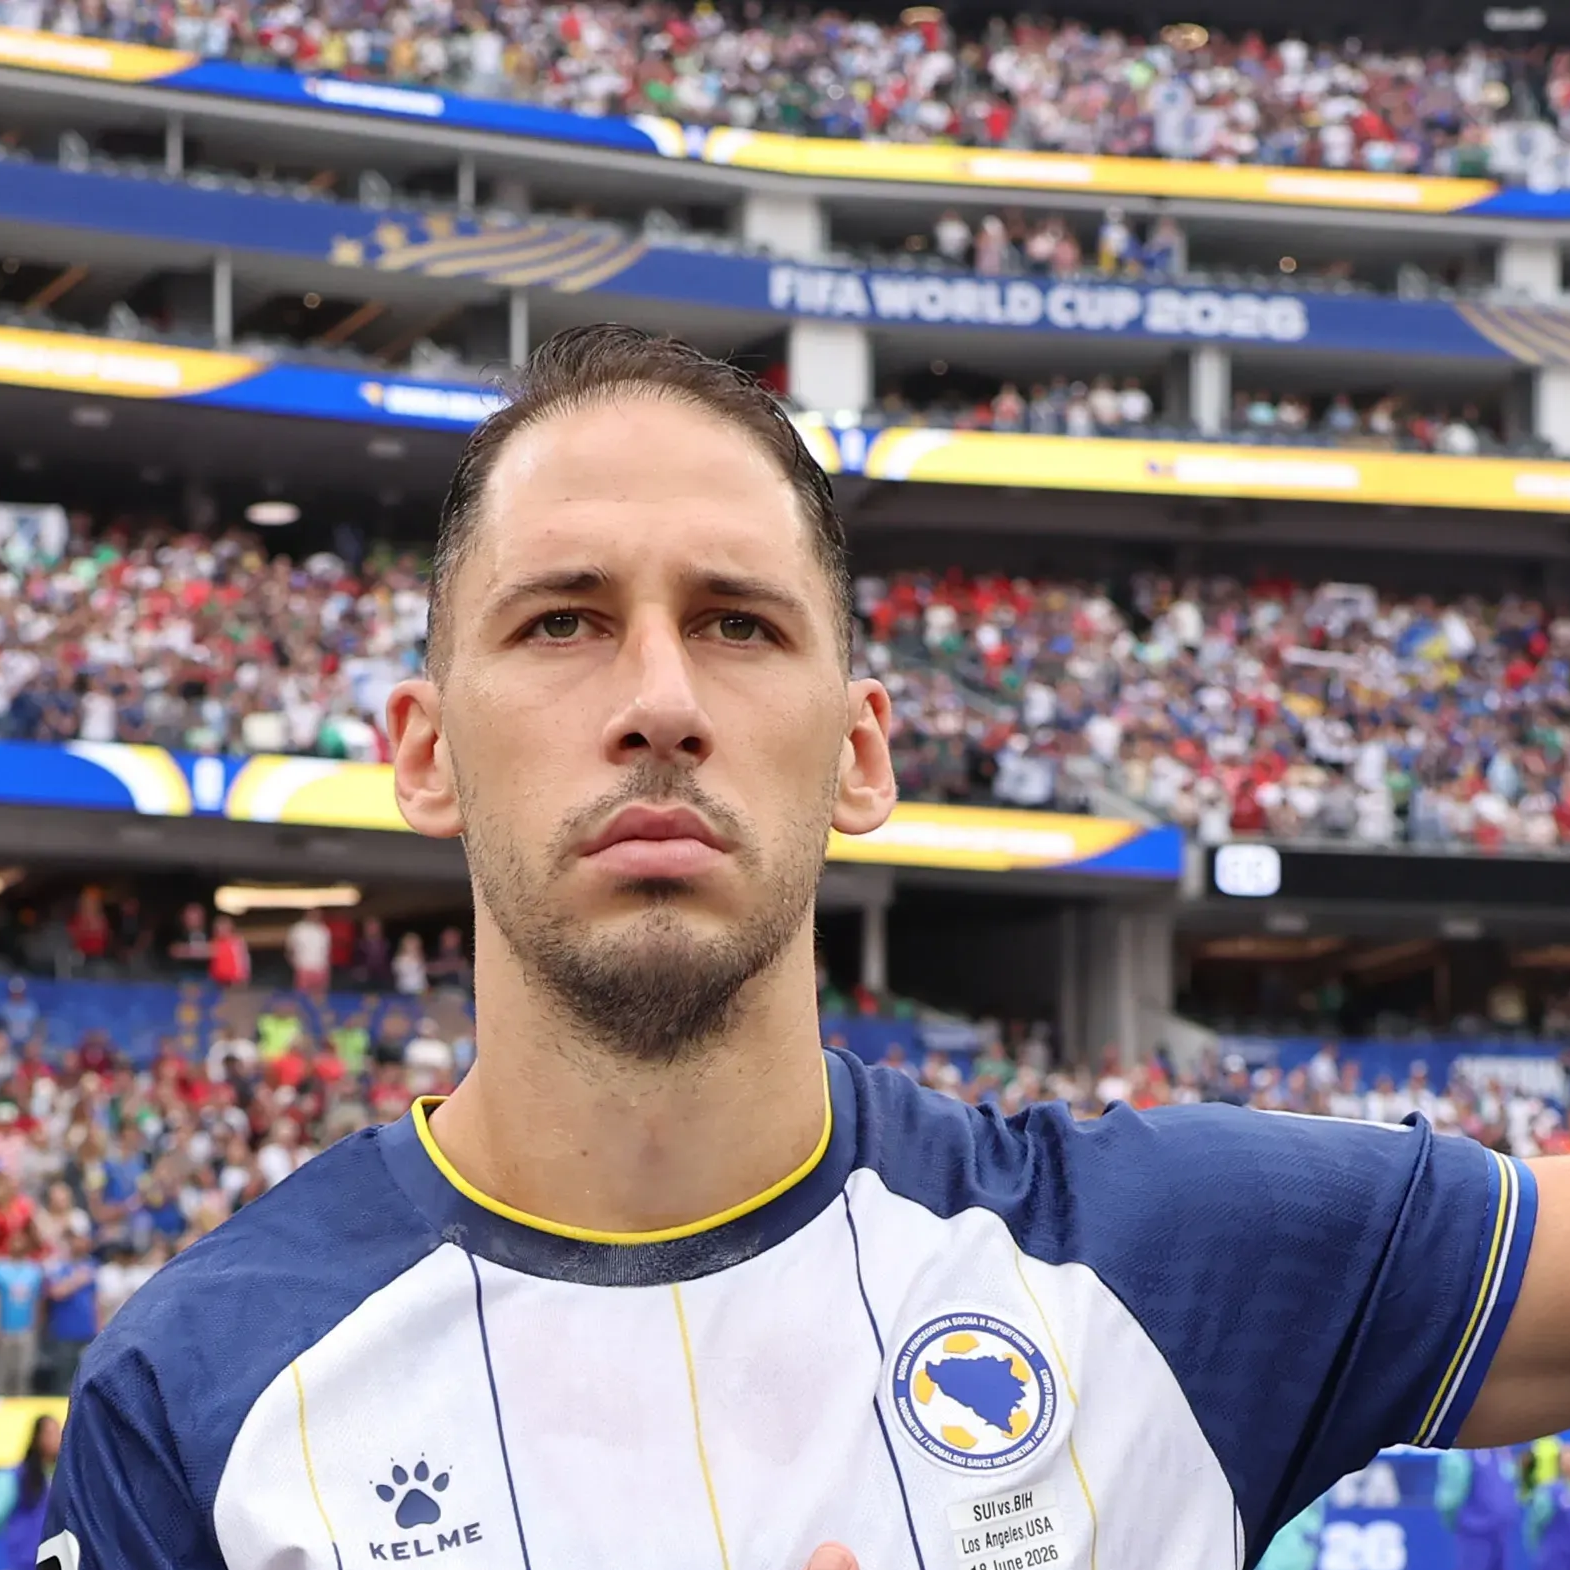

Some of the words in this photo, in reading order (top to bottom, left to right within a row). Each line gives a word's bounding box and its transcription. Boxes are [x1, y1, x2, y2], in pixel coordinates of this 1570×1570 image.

[767, 265, 869, 316] FIFA
[868, 276, 1042, 326] WORLD
[1046, 282, 1141, 331] CUP
[1143, 288, 1308, 341] 2026
[966, 1456, 992, 1468] SAVEZ
[973, 1501, 996, 1521] SUI
[369, 1522, 483, 1561] KELME
[961, 1538, 981, 1554] Los
[1024, 1544, 1059, 1567] 2026
